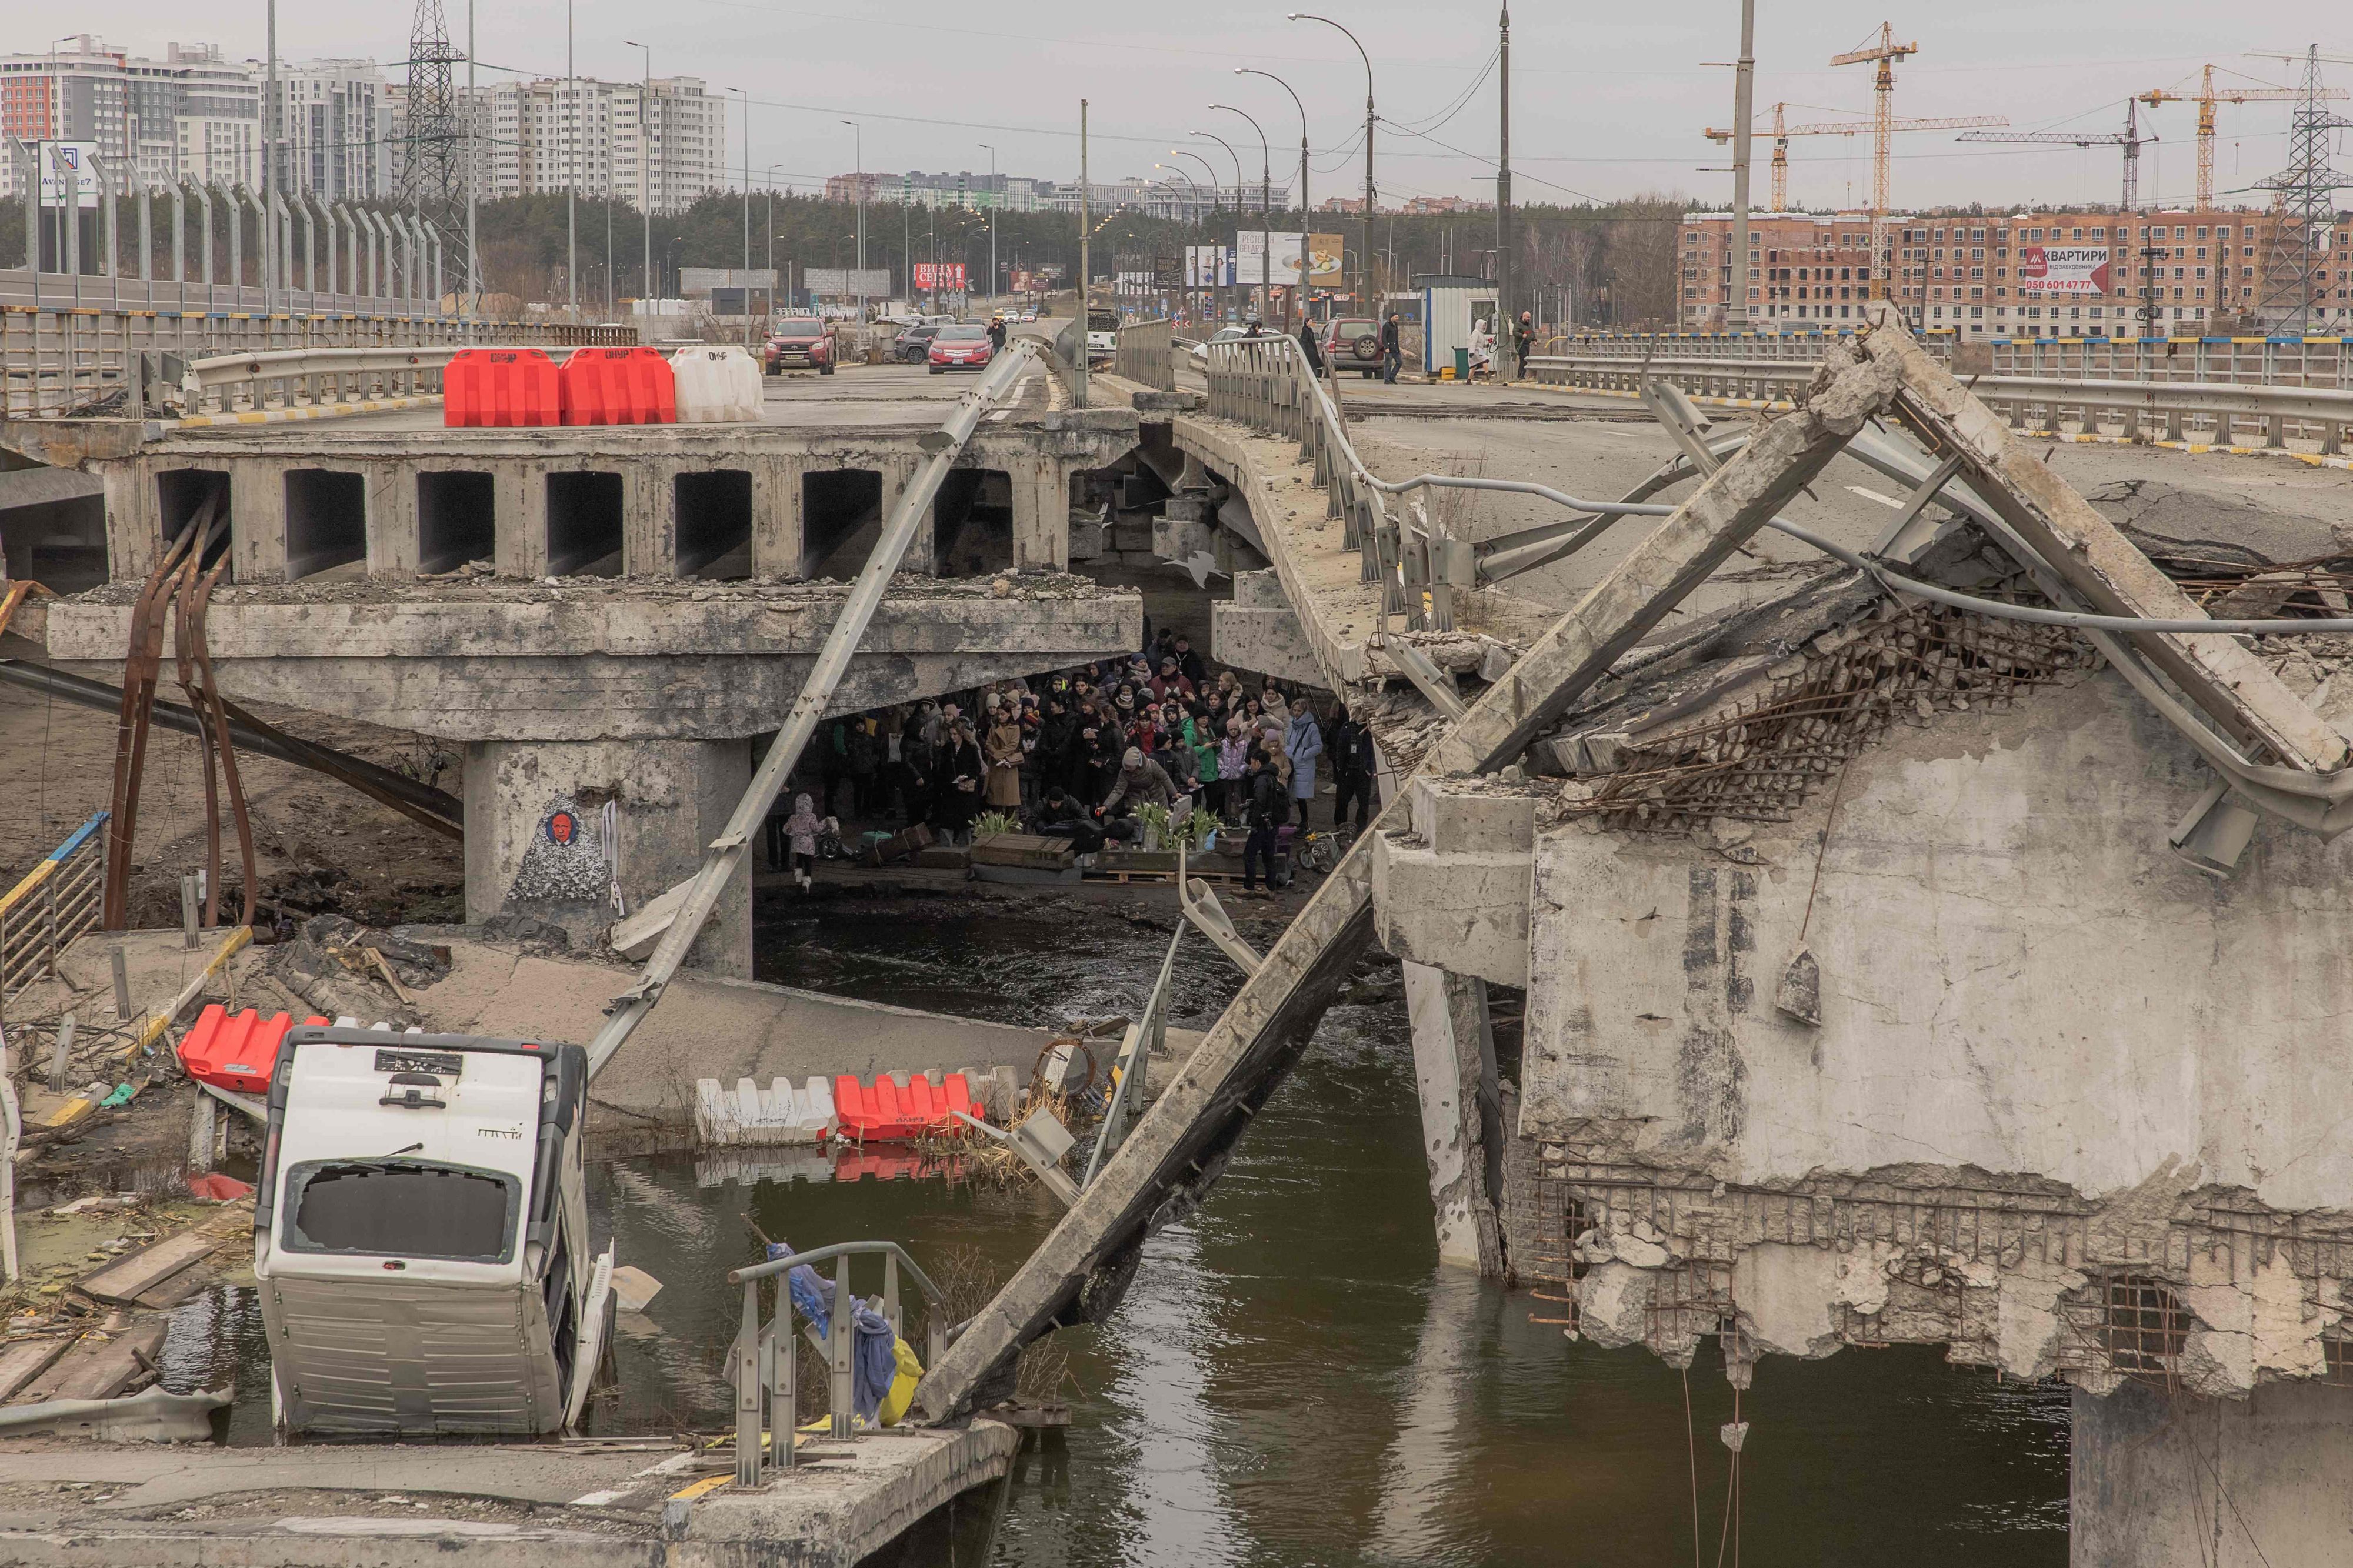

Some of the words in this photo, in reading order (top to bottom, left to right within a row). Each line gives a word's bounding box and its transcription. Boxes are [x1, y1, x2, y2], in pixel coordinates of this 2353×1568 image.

[1242, 235, 1274, 243] РЕСТОРН
[2043, 251, 2107, 261] КВАРТИРИ
[2026, 281, 2045, 289] 050
[2047, 281, 2064, 289] 601
[2066, 281, 2078, 289] 47
[2079, 281, 2091, 289] 77
